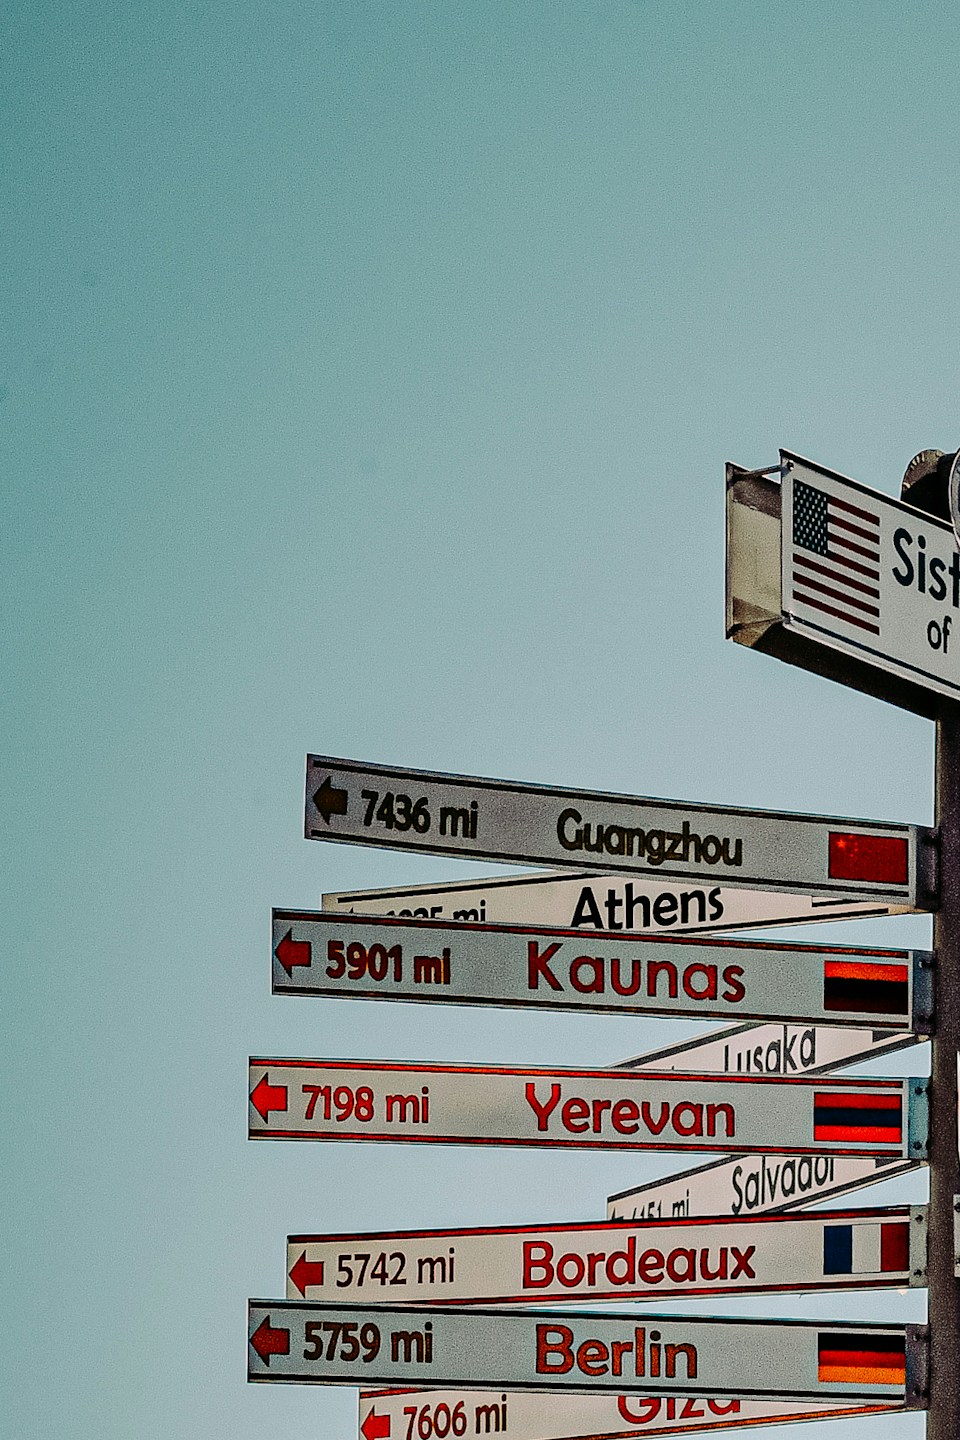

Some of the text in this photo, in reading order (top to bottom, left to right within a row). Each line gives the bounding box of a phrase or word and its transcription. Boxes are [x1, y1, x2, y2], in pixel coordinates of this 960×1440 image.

[927, 615, 952, 653] of
[362, 789, 743, 867] 7436 mi Guangzhou
[570, 882, 724, 930] Athens
[325, 941, 746, 1003] 5901 mi Kaunas
[302, 1082, 736, 1138] 7198 mi Yerevan
[336, 1236, 757, 1289] 5742 mi Bordeaux
[303, 1321, 698, 1380] 5759 mi Berlin
[474, 1395, 508, 1435] mi
